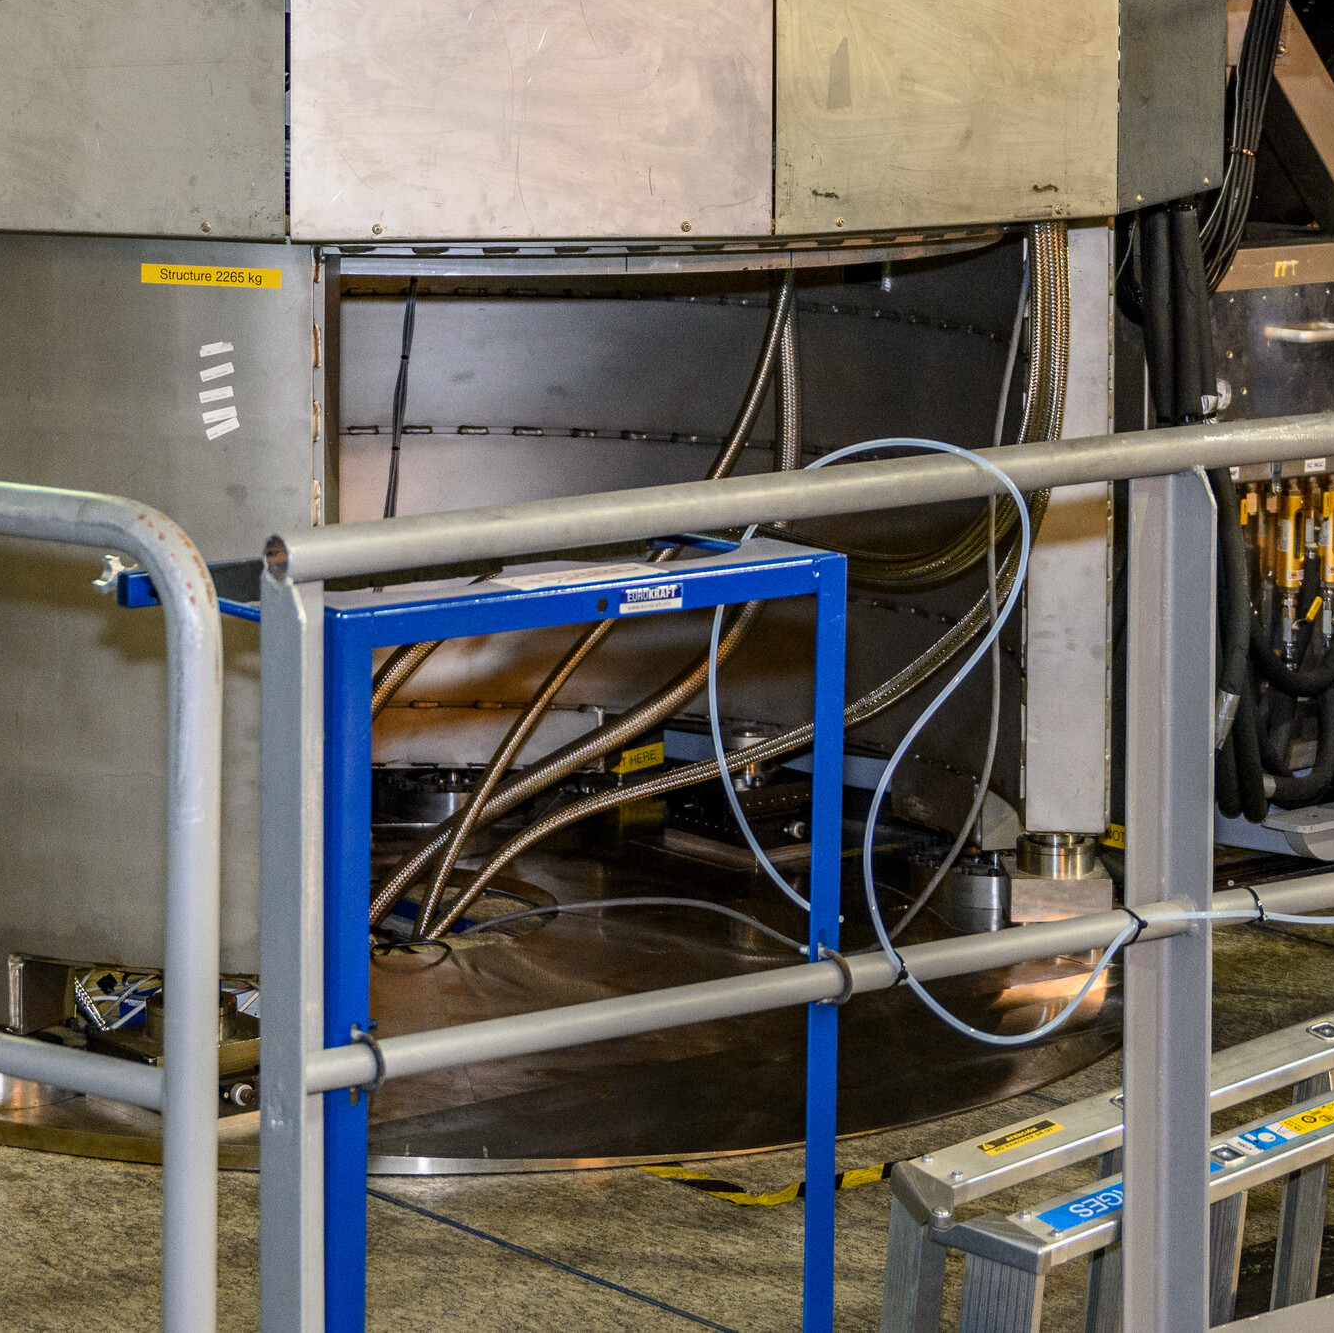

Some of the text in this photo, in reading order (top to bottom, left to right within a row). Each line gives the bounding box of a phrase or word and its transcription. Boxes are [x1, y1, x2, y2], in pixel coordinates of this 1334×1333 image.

[160, 269, 263, 285] Structure 2265 kg
[627, 585, 677, 602] EUROKRAFT
